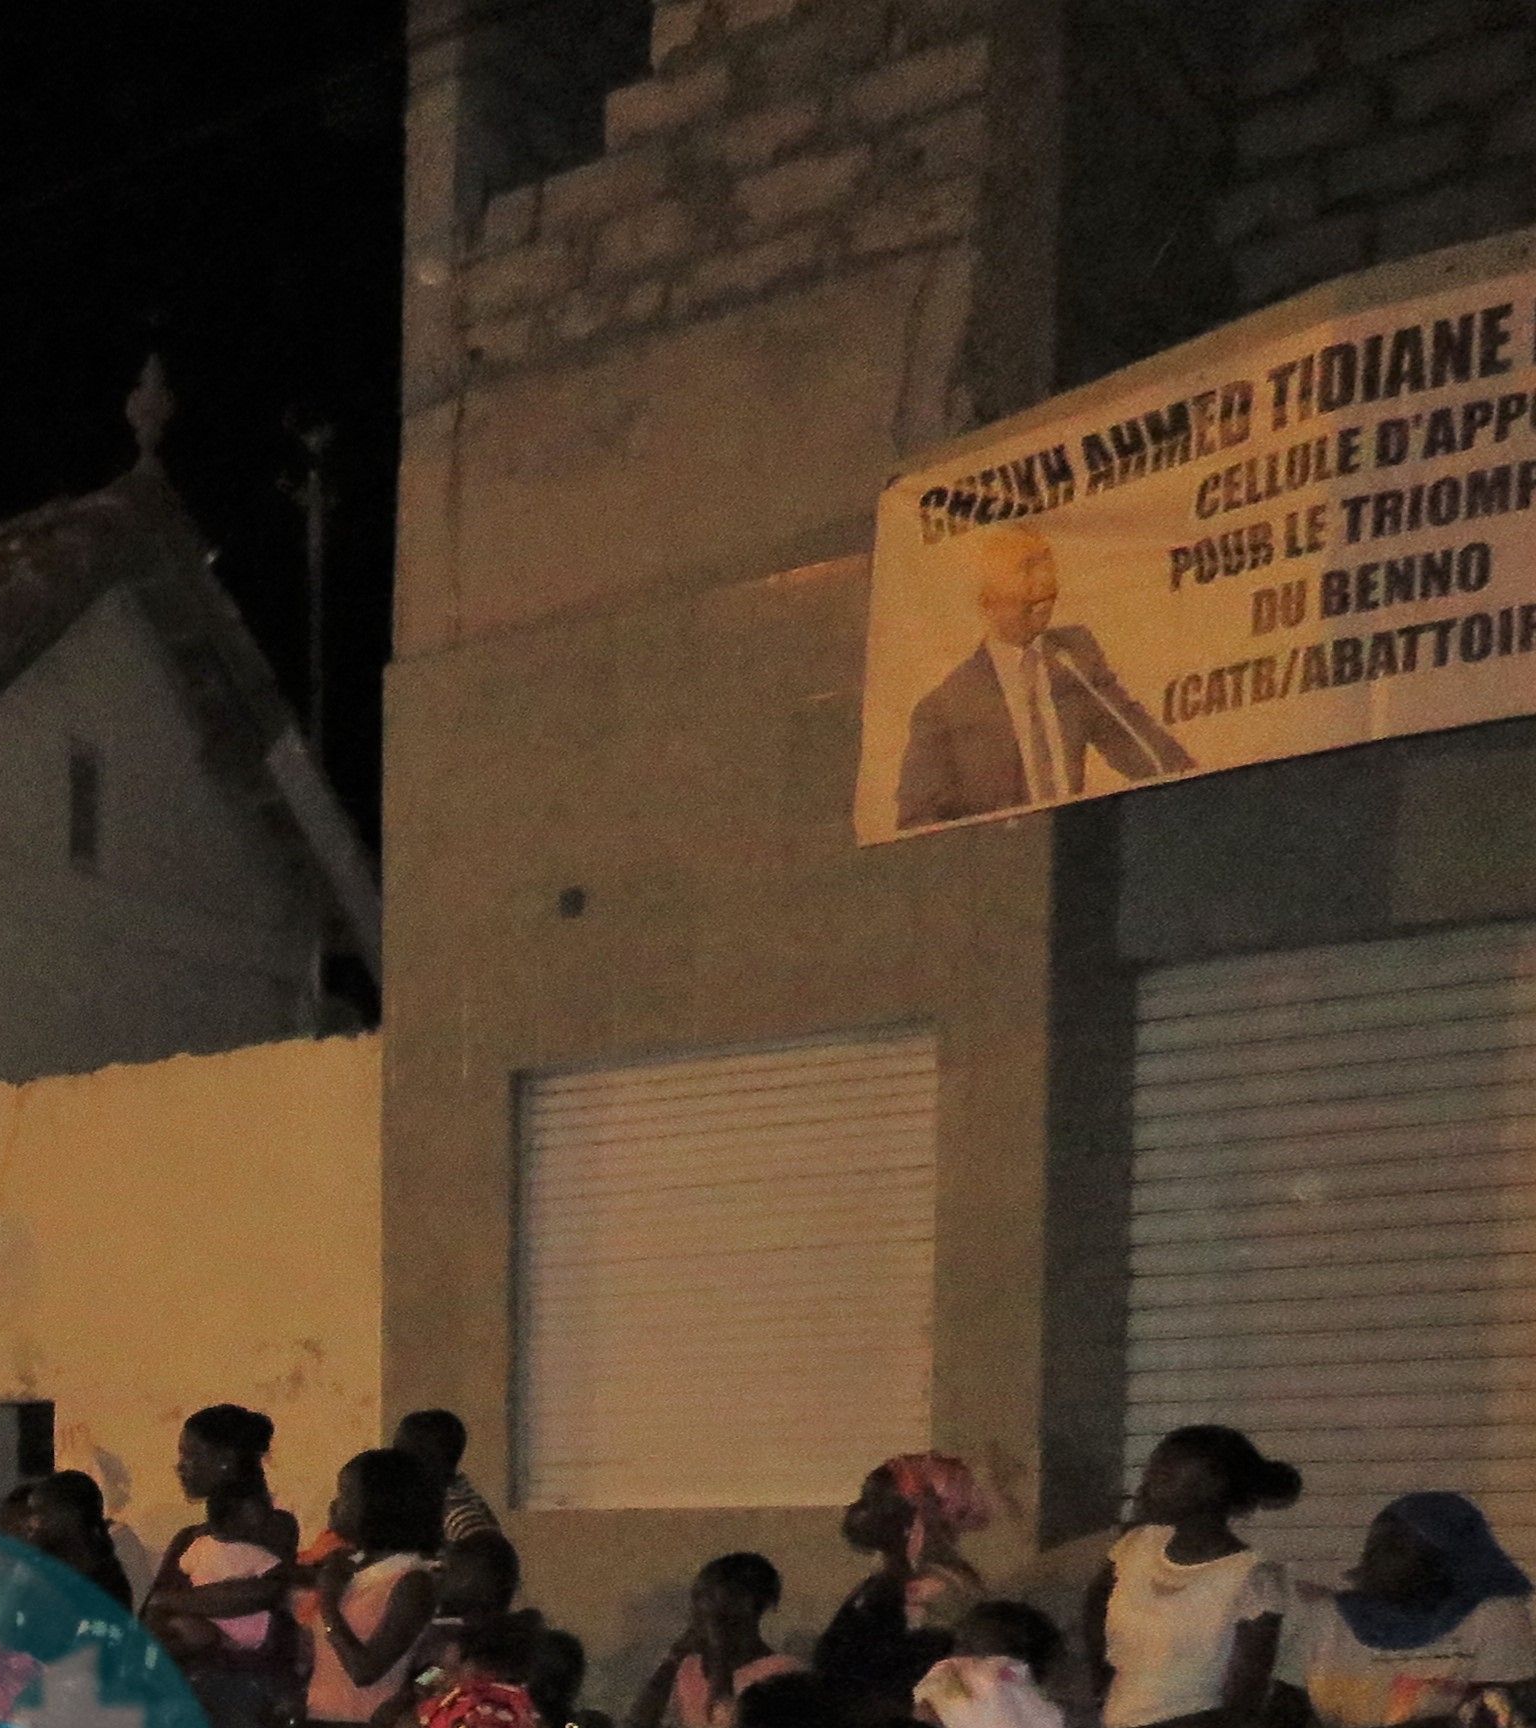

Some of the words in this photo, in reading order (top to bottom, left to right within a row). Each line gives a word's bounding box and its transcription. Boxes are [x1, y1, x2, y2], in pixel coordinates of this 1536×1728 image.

[918, 443, 1075, 545] CHEIKH
[1080, 383, 1254, 496] AHMED
[1268, 303, 1514, 432] TIDIANE
[1194, 426, 1363, 520] CELLULE
[1375, 388, 1536, 468] D'APP
[1169, 521, 1274, 592] POUR
[1283, 504, 1326, 559] LE
[1251, 578, 1306, 635] DU
[1320, 541, 1491, 618] BENNO
